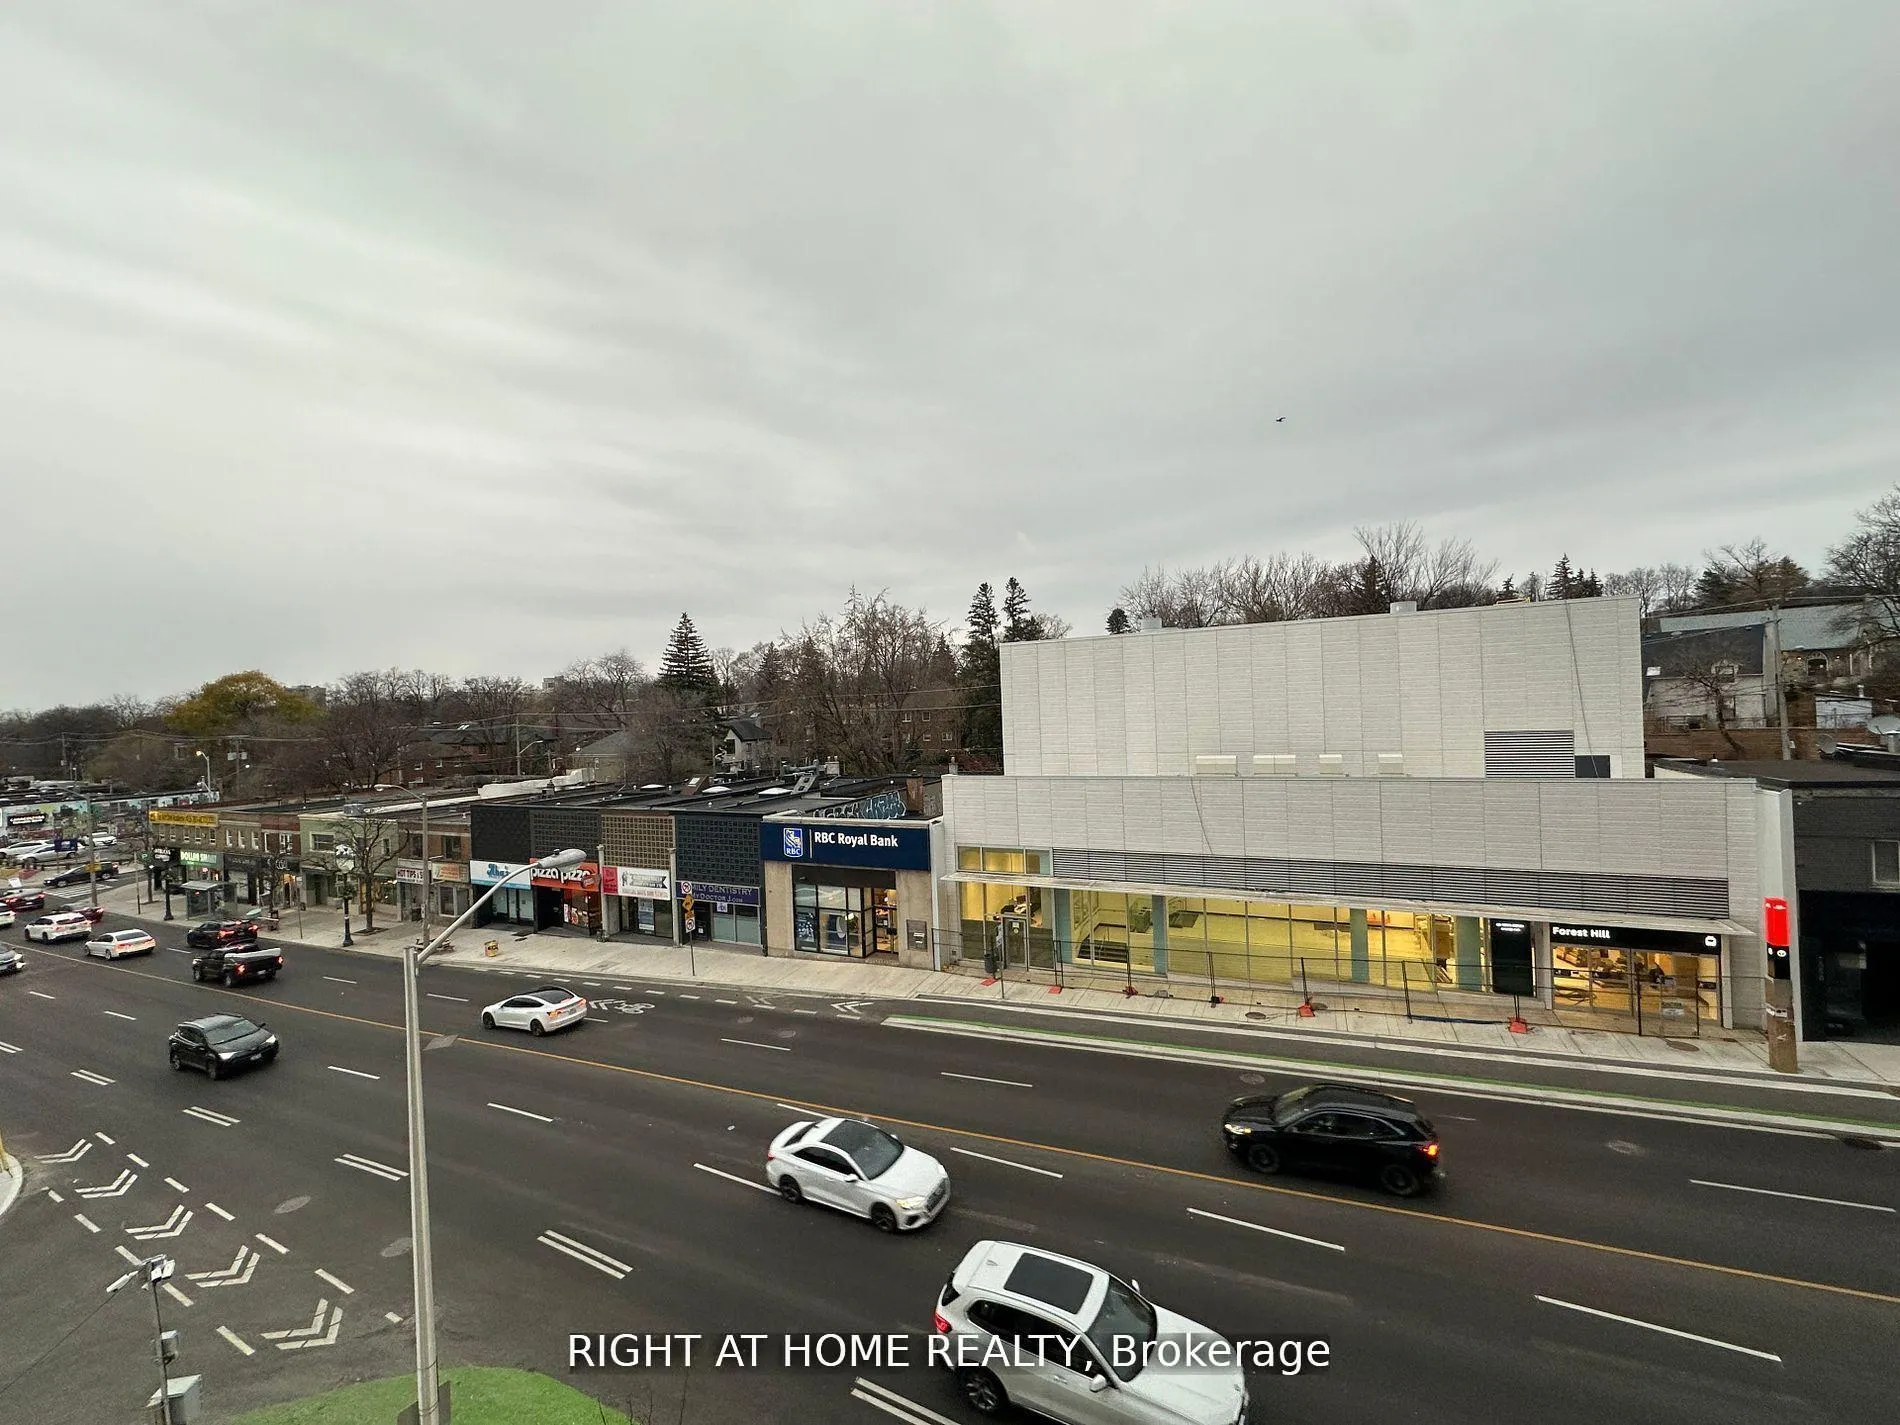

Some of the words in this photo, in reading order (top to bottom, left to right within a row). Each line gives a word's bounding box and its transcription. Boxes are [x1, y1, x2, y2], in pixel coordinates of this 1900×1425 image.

[814, 831, 836, 844] RBC
[838, 832, 868, 848] Royal
[870, 834, 899, 848] Bank
[530, 867, 559, 880] pizza
[709, 885, 752, 896] DENTISTRY
[1552, 926, 1589, 938] Forest
[1590, 929, 1611, 939] Hill
